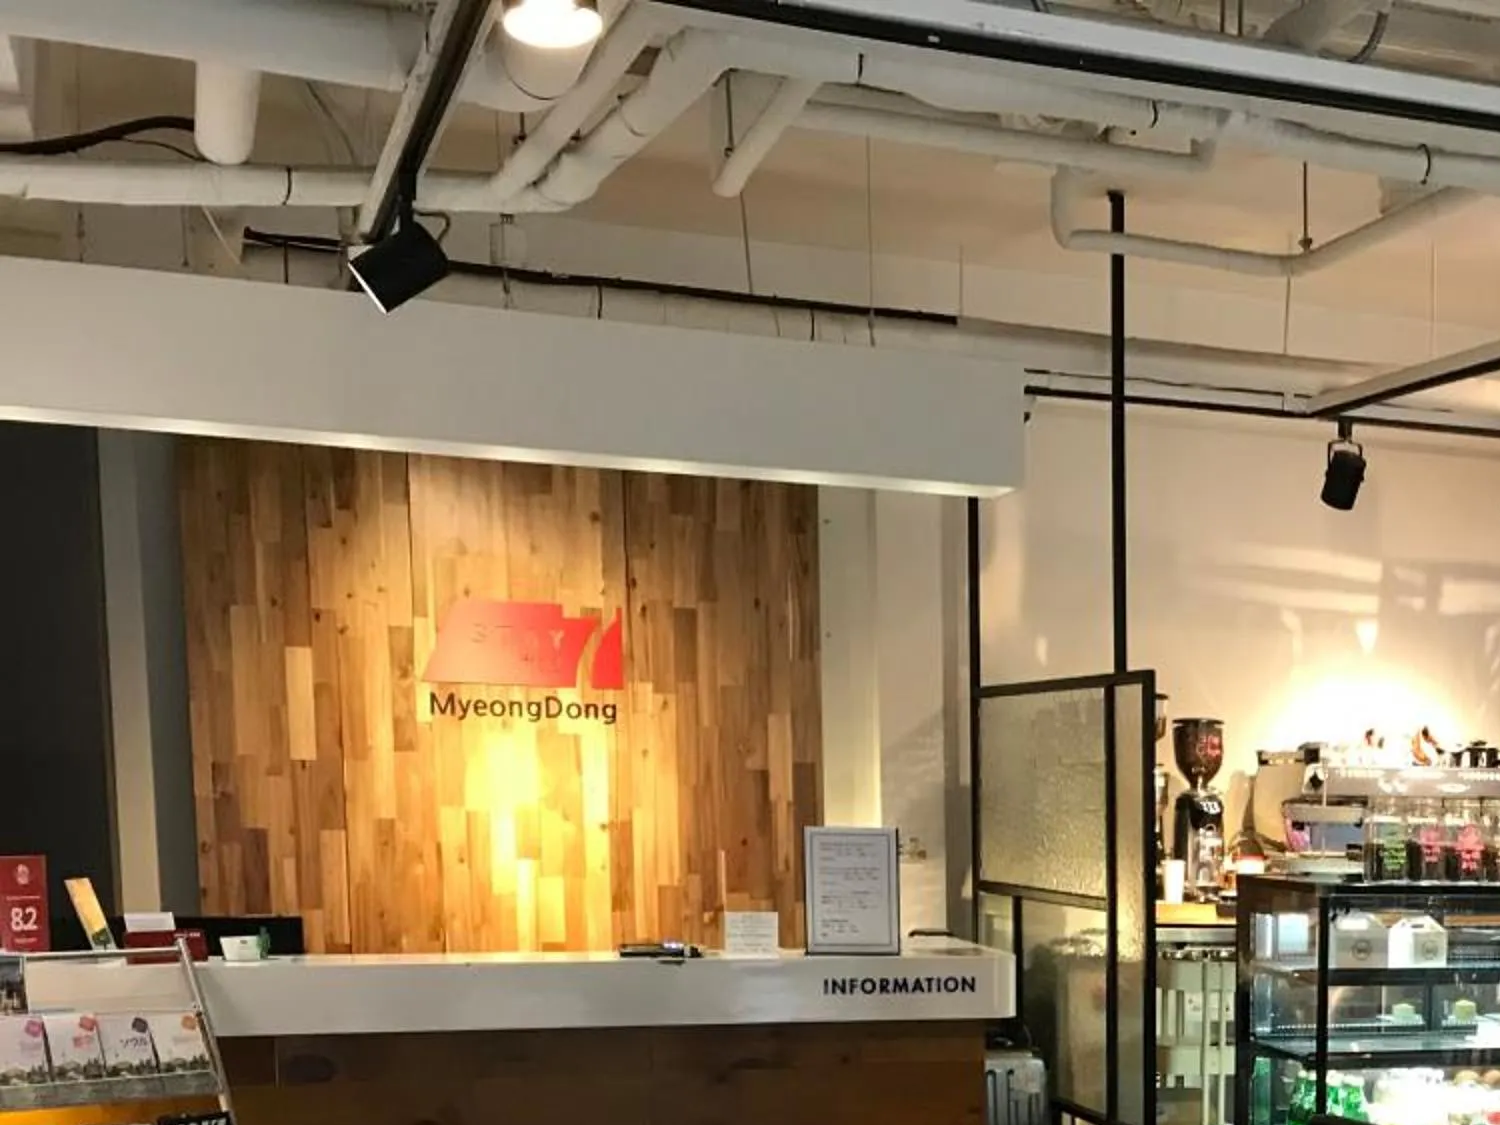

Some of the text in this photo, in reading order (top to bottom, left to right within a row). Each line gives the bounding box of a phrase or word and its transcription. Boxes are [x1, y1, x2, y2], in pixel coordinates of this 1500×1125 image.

[429, 691, 618, 726] MyeongDong
[10, 907, 39, 932] 82
[823, 976, 977, 995] INFORMATION
